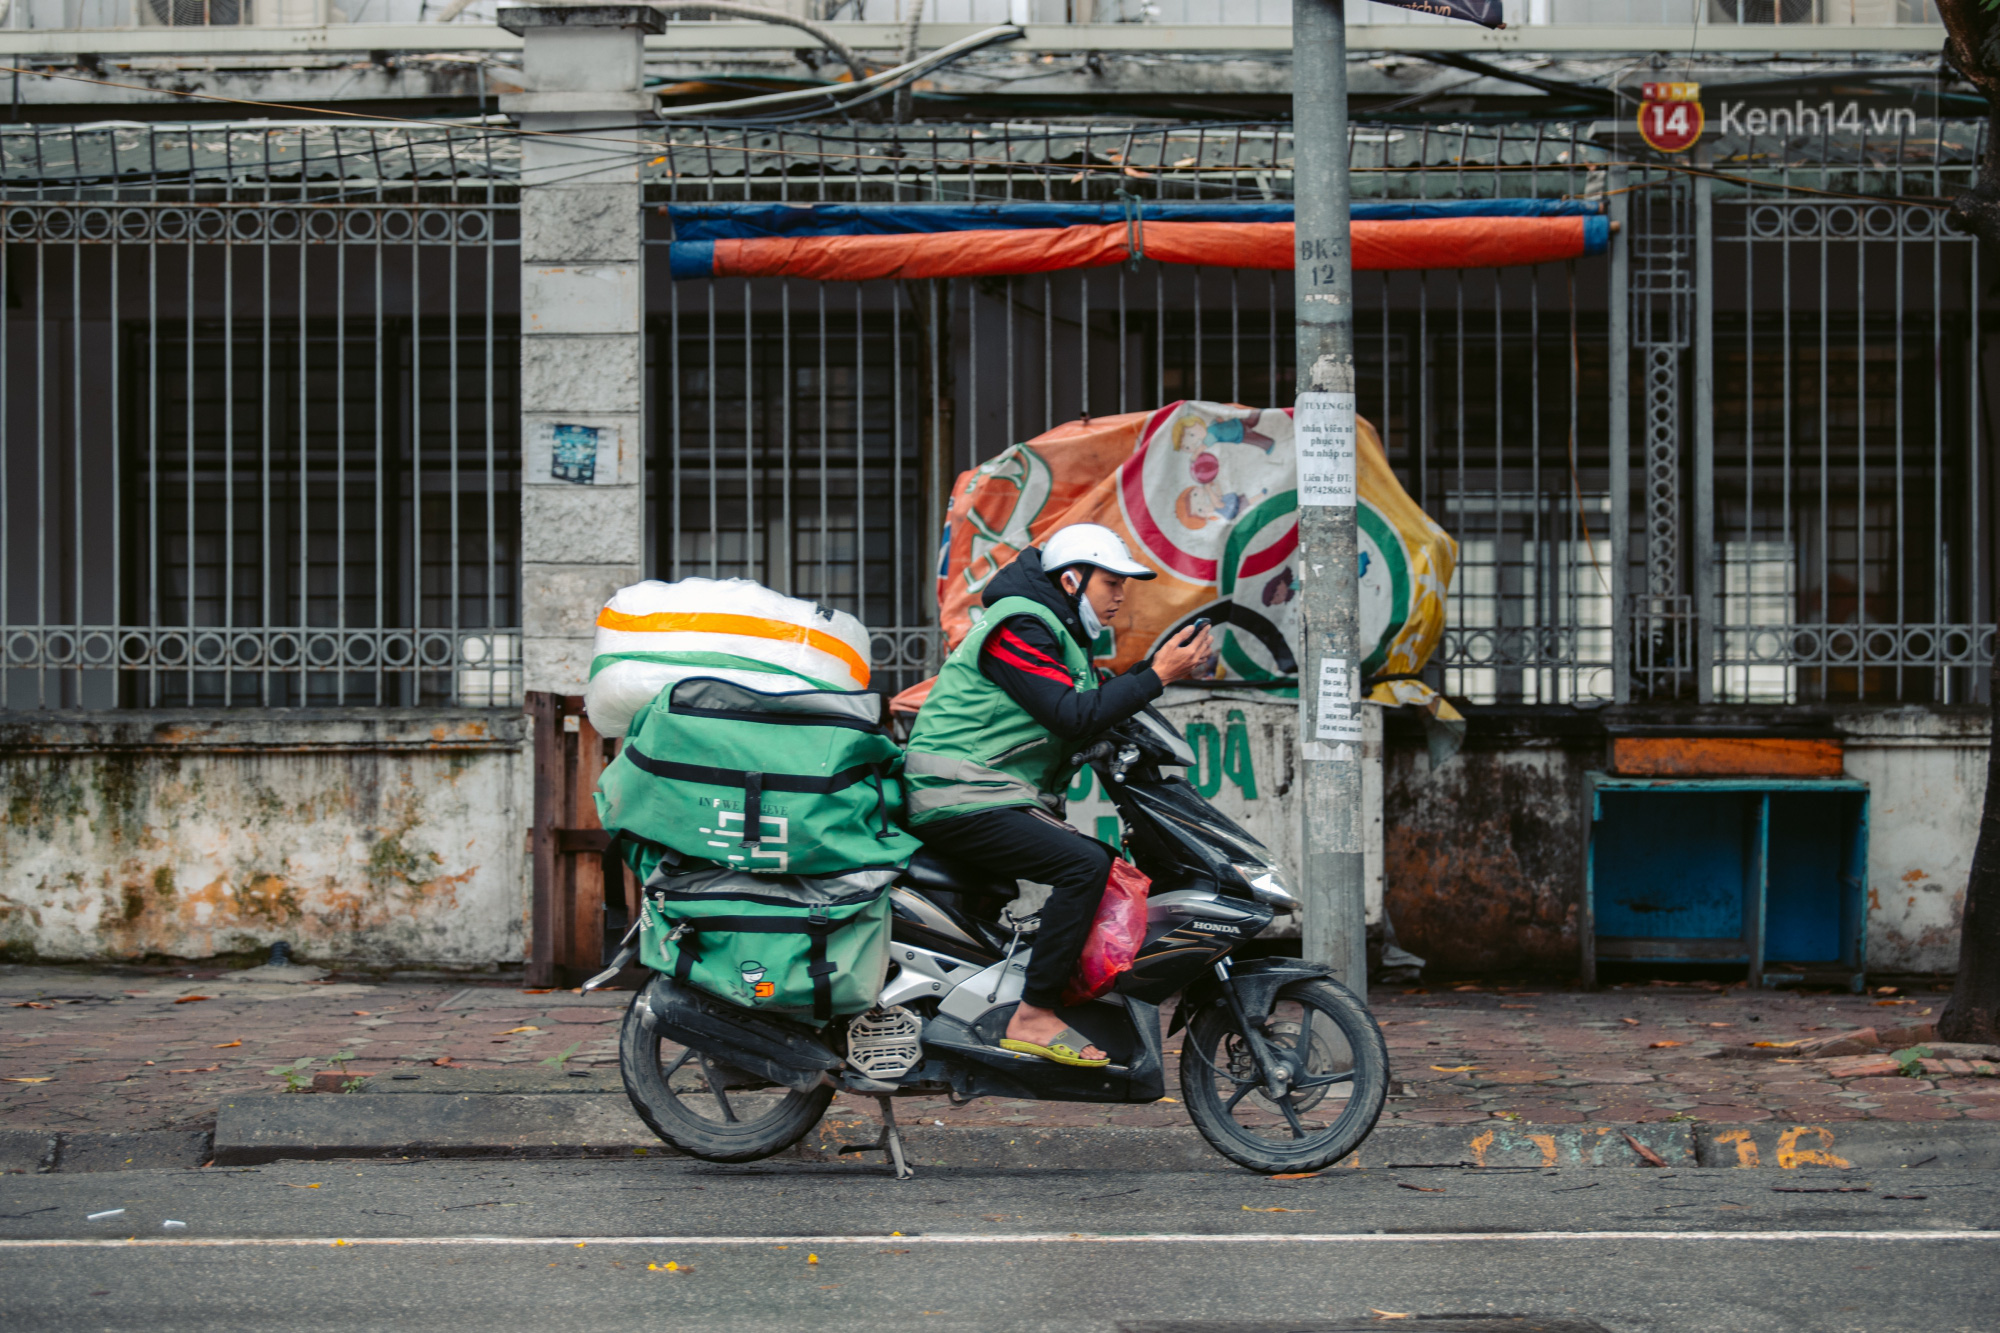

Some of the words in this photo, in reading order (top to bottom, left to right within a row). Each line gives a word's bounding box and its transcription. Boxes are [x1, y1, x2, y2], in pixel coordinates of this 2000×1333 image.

[1312, 264, 1335, 286] 12
[699, 797, 711, 807] IN
[713, 798, 721, 808] F
[722, 800, 740, 810] WE
[1193, 921, 1241, 934] HONDA
